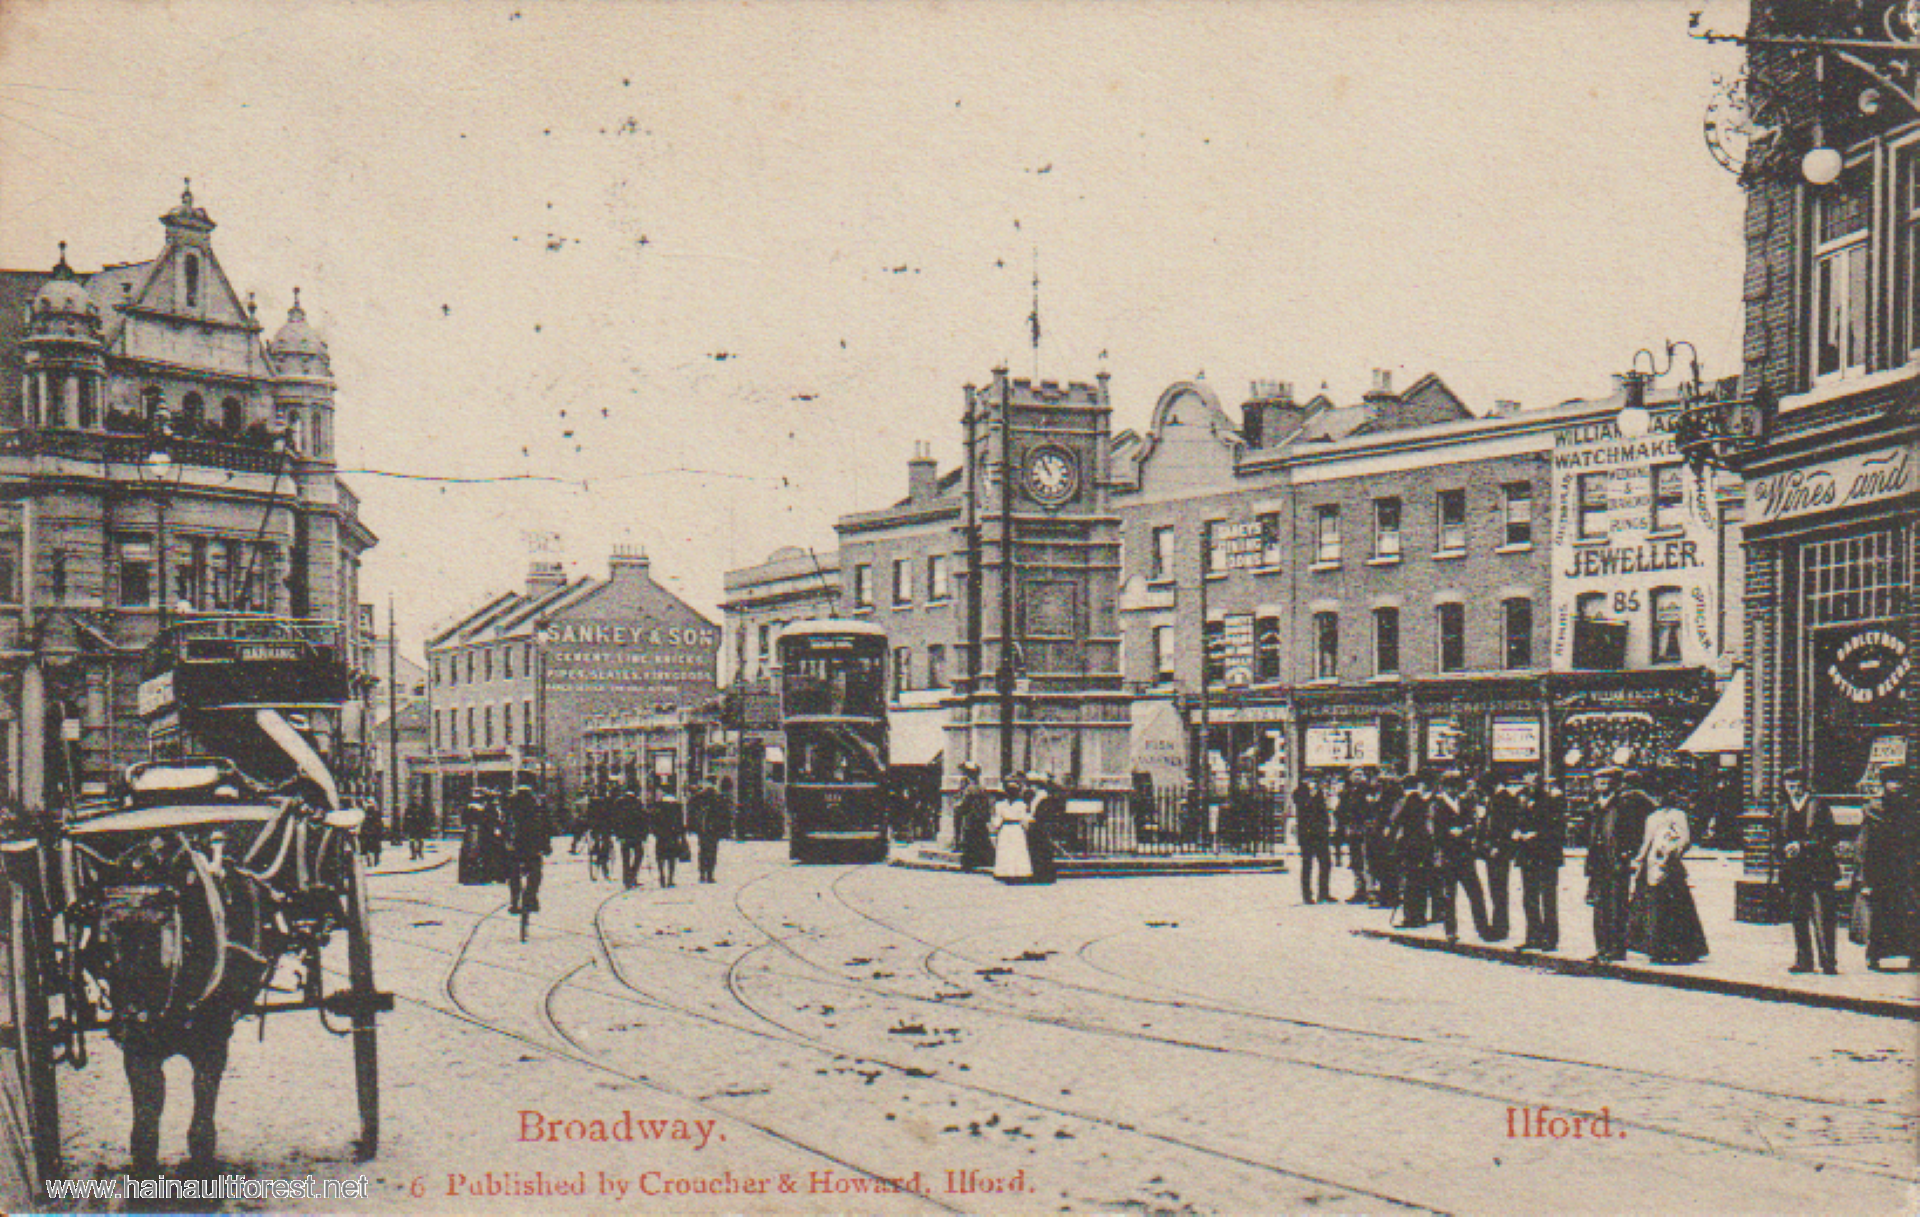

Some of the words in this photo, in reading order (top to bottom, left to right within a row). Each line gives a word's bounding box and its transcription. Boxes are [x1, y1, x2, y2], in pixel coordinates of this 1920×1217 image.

[1755, 469, 1836, 520] Wines
[1842, 449, 1909, 506] and
[1565, 540, 1704, 579] JEWELLER.
[1614, 589, 1641, 614] 85
[546, 624, 643, 644] SANKEY
[649, 628, 662, 645] &
[668, 627, 713, 647] SON
